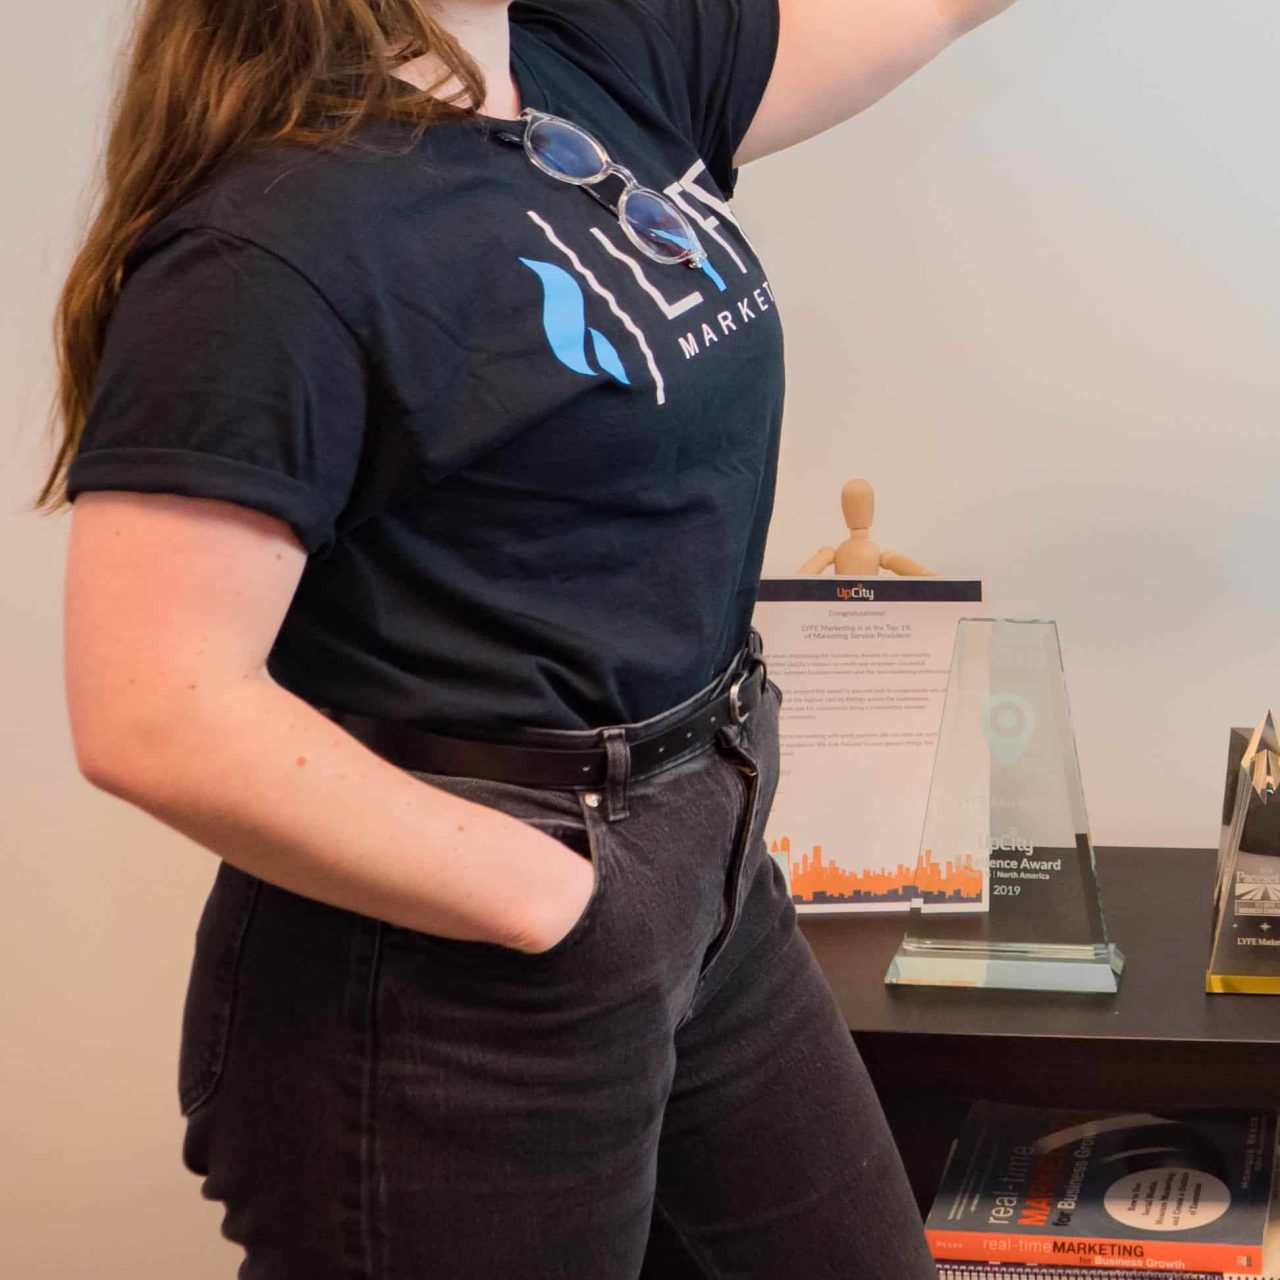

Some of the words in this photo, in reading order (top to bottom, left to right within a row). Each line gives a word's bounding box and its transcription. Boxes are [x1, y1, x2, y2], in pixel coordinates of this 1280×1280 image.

[678, 280, 776, 360] MARKET
[836, 584, 875, 601] UpCity
[1020, 858, 1061, 870] Award
[997, 871, 1018, 879] North
[1019, 872, 1050, 880] America
[993, 885, 1021, 896] 2019
[988, 1145, 1035, 1224] real-time
[1058, 1160, 1090, 1210] Business
[1052, 1210, 1072, 1227] for
[982, 1237, 1051, 1253] real-time
[1052, 1240, 1144, 1258] MARKETING
[1079, 1256, 1092, 1264] for
[1095, 1255, 1143, 1267] Business
[1145, 1257, 1185, 1270] Growth
